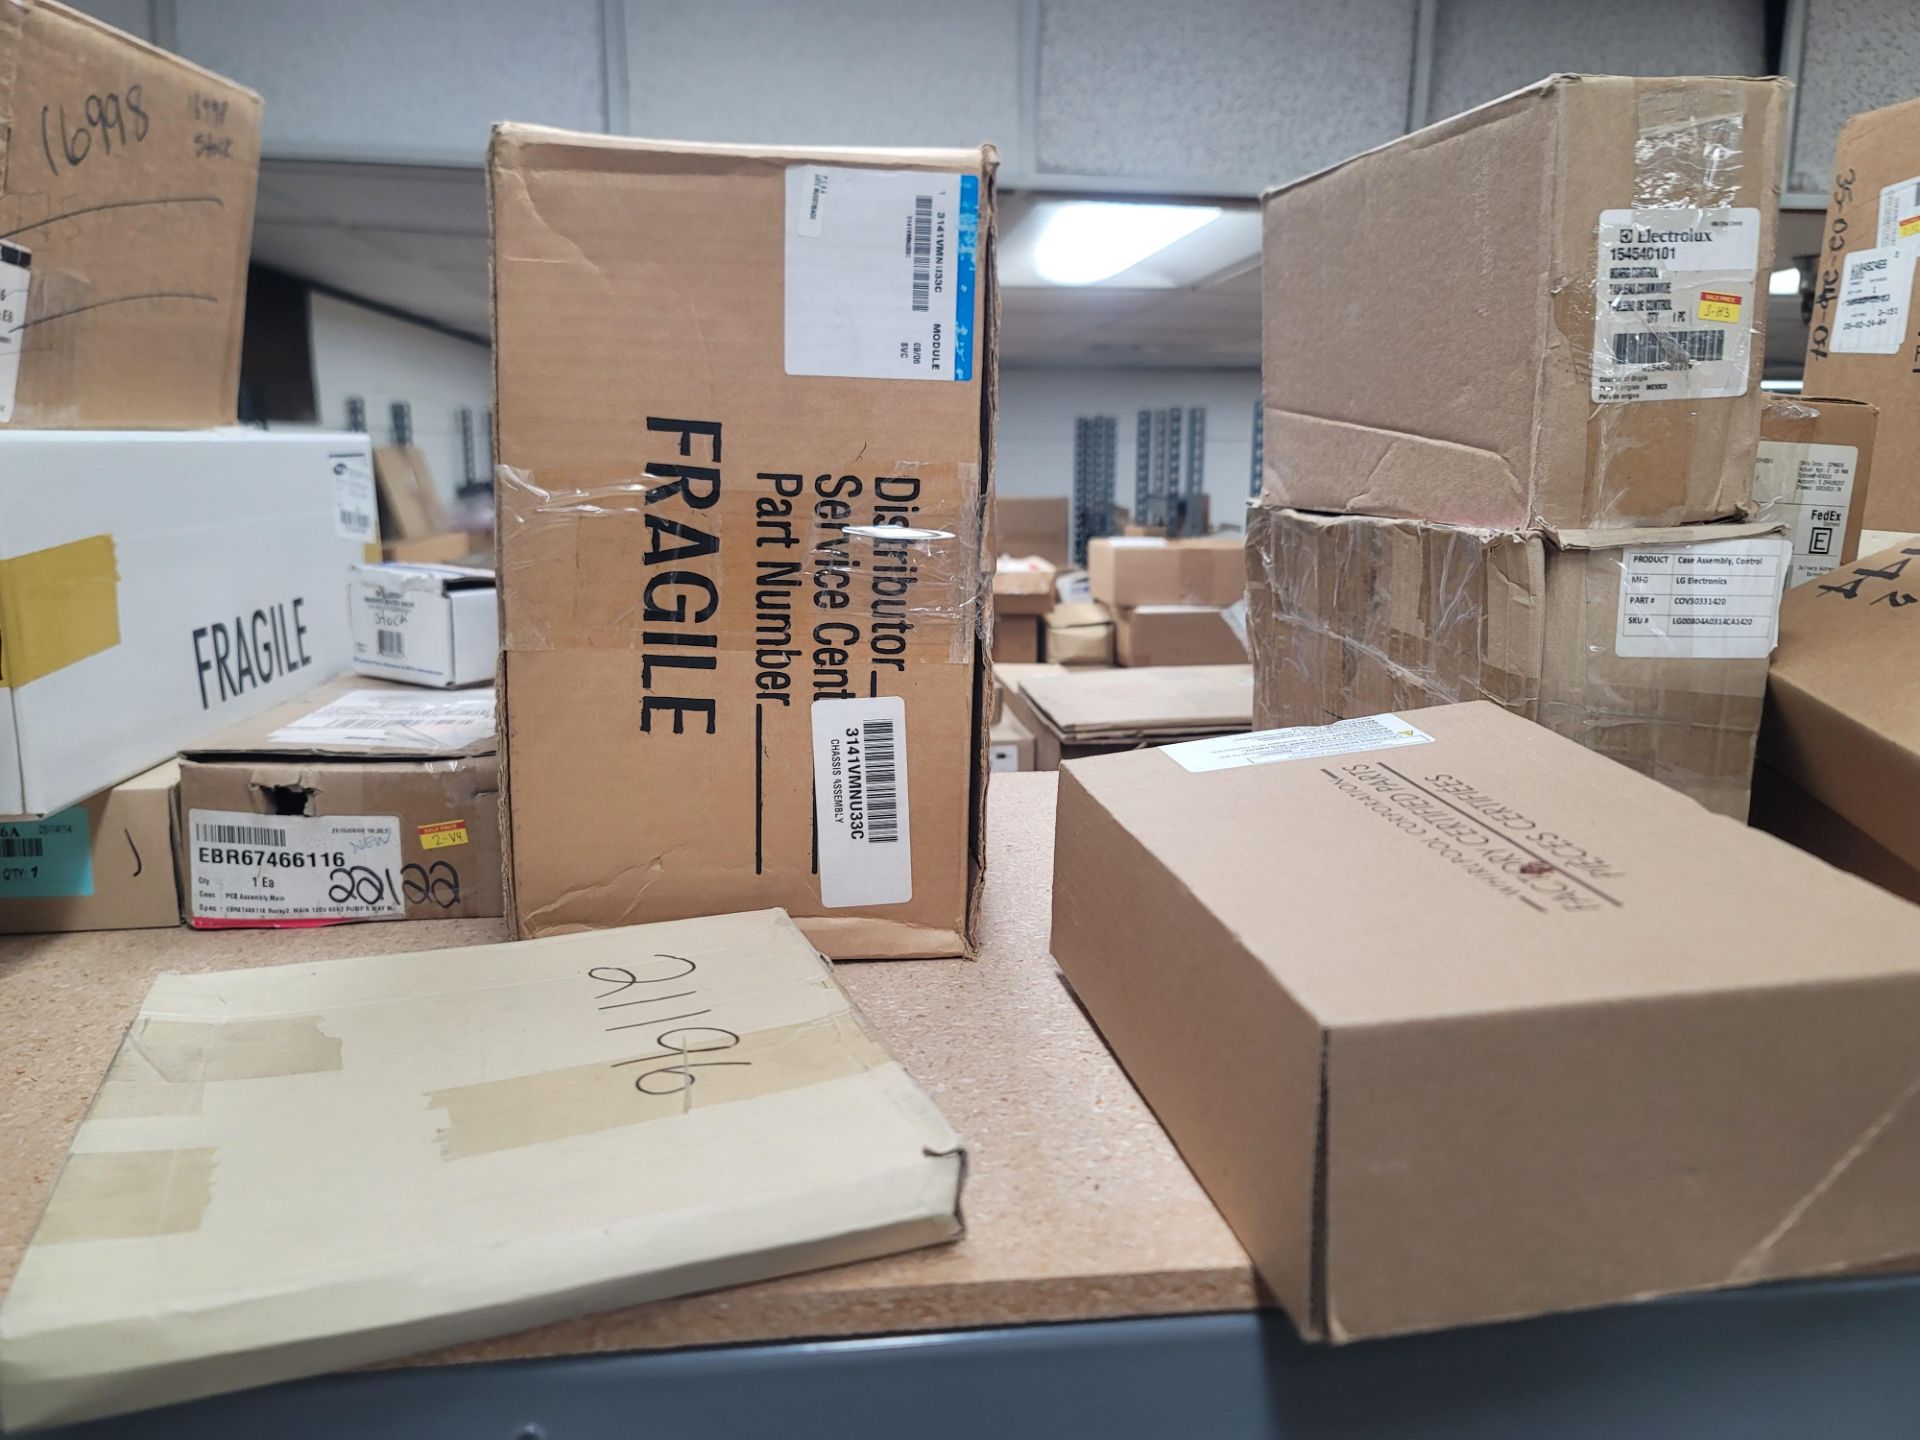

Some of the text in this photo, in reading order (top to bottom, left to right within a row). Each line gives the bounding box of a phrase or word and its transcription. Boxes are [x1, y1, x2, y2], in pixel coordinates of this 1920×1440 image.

[41, 84, 150, 177] 16998
[1637, 228, 1713, 243] Electrolux
[1610, 247, 1676, 260] 154540101
[900, 342, 909, 359] SVC
[931, 323, 942, 371] MODULE
[1811, 510, 1841, 521] FedEx
[814, 474, 863, 610] Service
[1814, 532, 1828, 550] E
[1697, 557, 1734, 566] Assembly,
[641, 416, 722, 735] FRAGILE
[1676, 577, 1686, 585] LG
[1688, 577, 1727, 585] Electronics
[755, 472, 803, 707] Part Number
[193, 597, 312, 711] FRAGILE
[830, 739, 844, 824] CHASSIS ASSEMBLY
[846, 728, 864, 840] 3141VMNU33C
[1342, 764, 1405, 792] PARTS
[1389, 793, 1489, 846] CERTIFIED
[349, 827, 392, 854] NEW
[199, 847, 345, 868] EBR67466116
[262, 876, 275, 888] Ea
[328, 861, 461, 909] 22122
[199, 903, 217, 912] Spec
